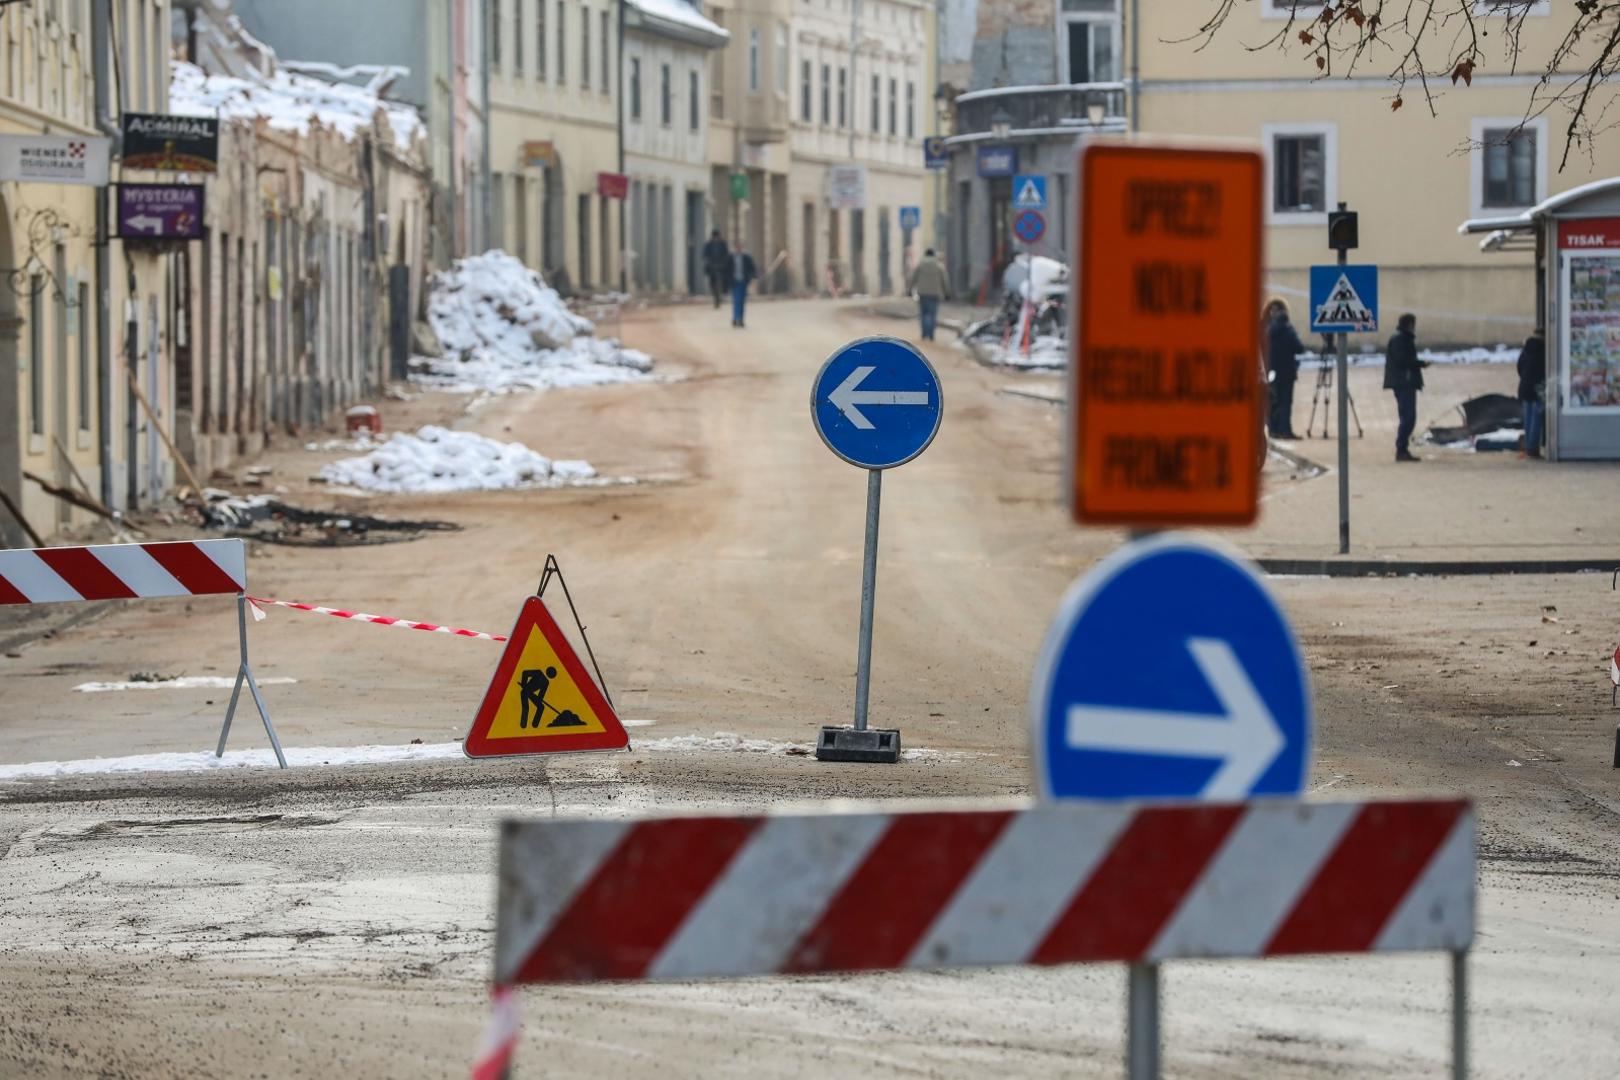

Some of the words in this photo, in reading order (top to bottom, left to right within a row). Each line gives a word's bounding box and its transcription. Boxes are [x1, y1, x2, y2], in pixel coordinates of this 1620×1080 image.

[128, 118, 214, 137] ADMIRAL
[20, 147, 66, 158] WIENER
[124, 188, 196, 203] MYSTERIA
[1567, 234, 1605, 246] TISAK
